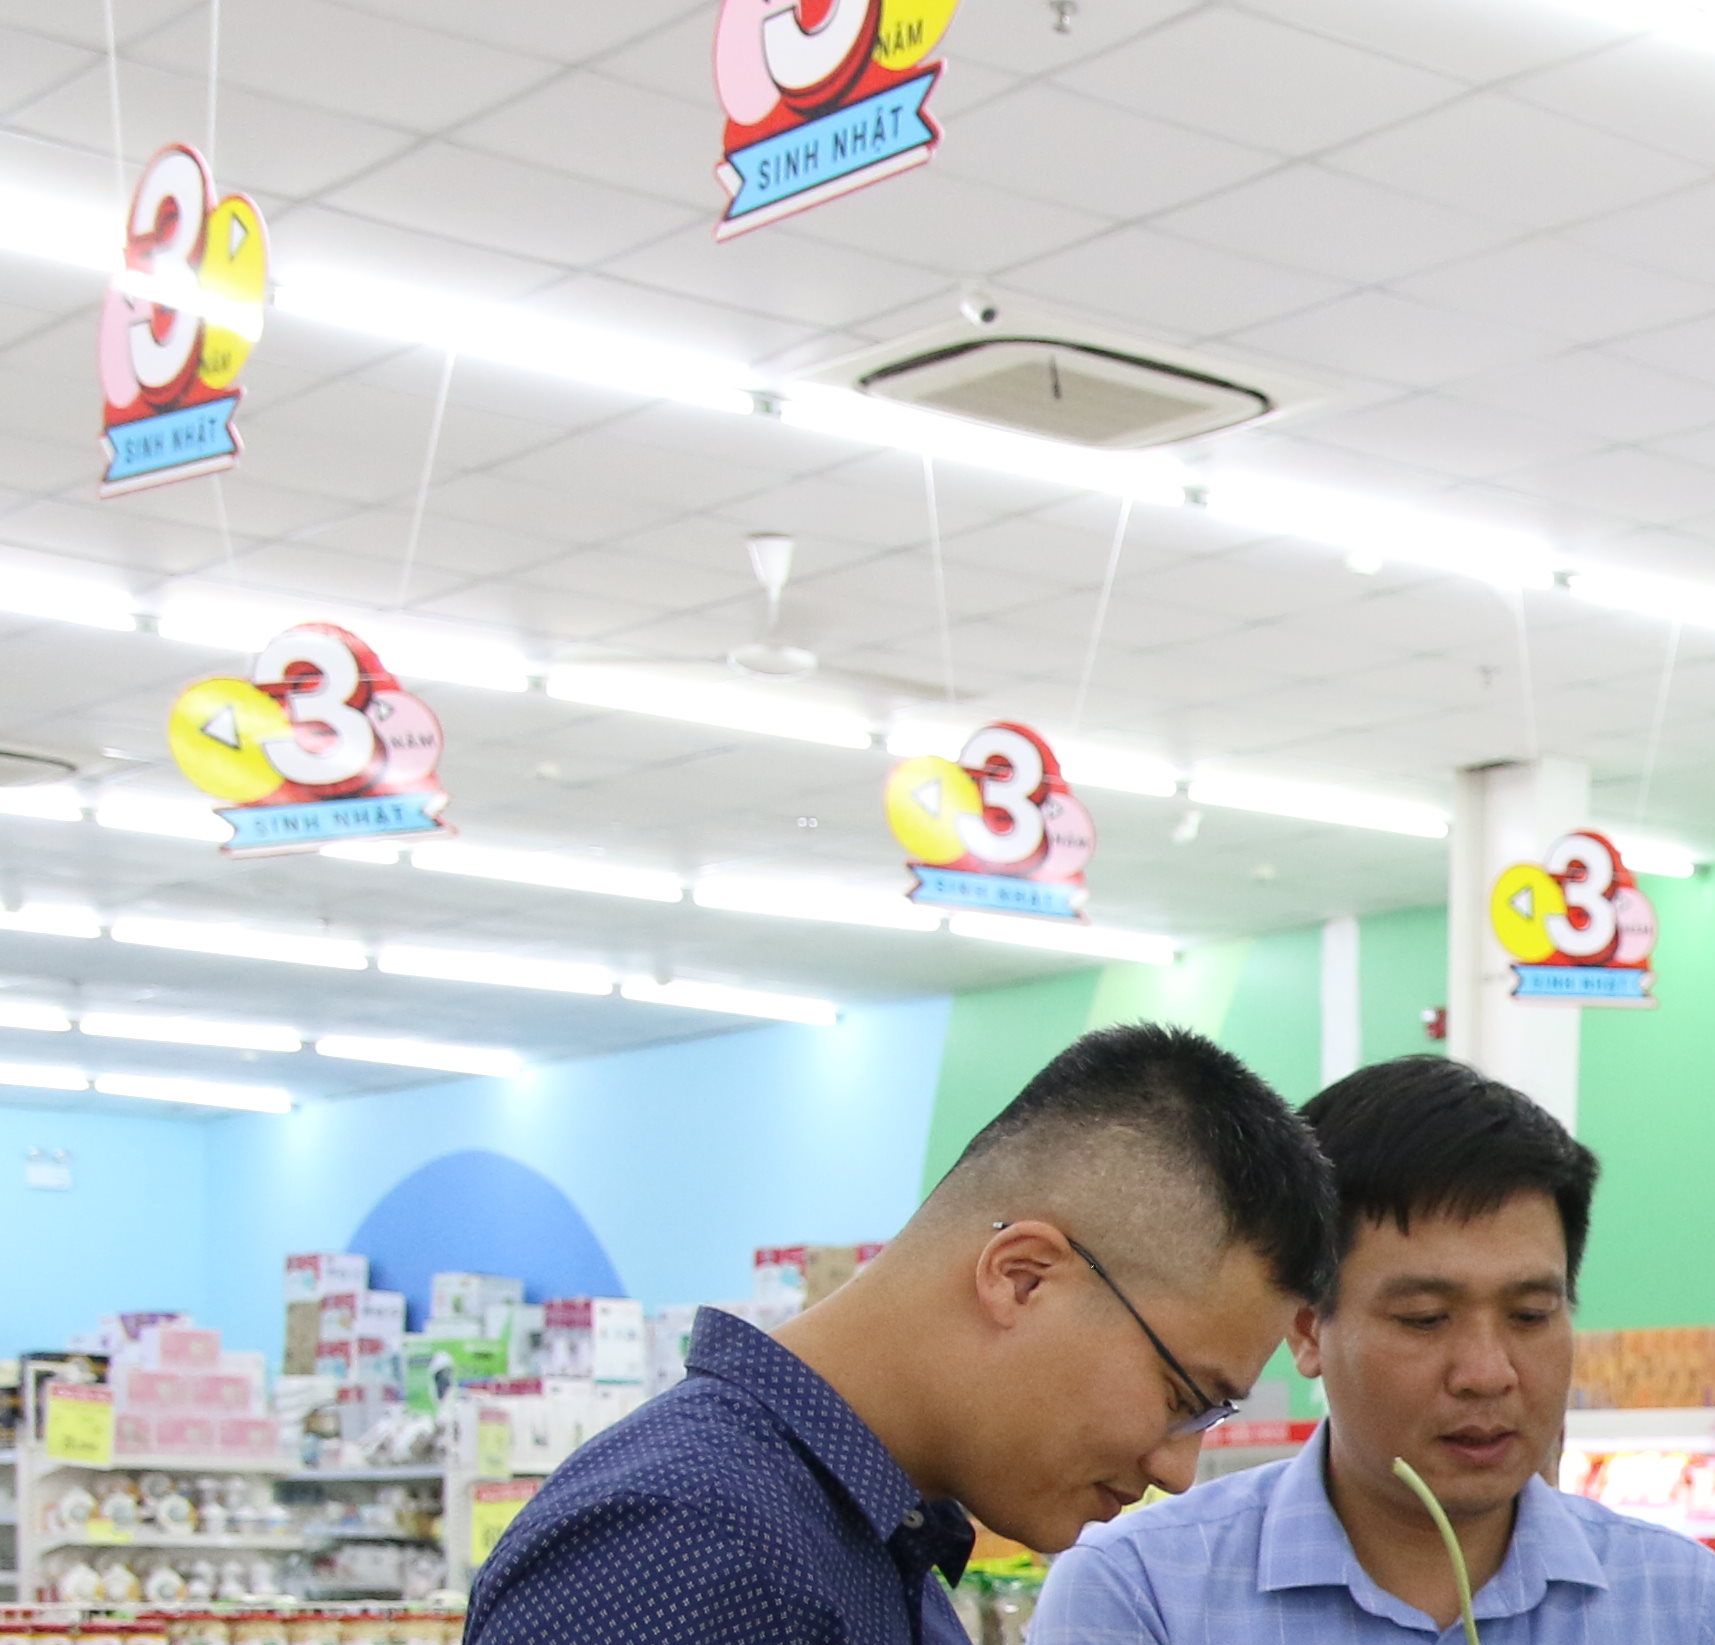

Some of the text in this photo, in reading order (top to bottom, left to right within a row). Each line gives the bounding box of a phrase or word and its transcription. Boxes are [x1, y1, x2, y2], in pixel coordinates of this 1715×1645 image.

[757, 106, 903, 190] SINH NHẬT
[253, 630, 375, 785] 3
[957, 726, 1045, 865] 3
[1545, 833, 1615, 957] 3
